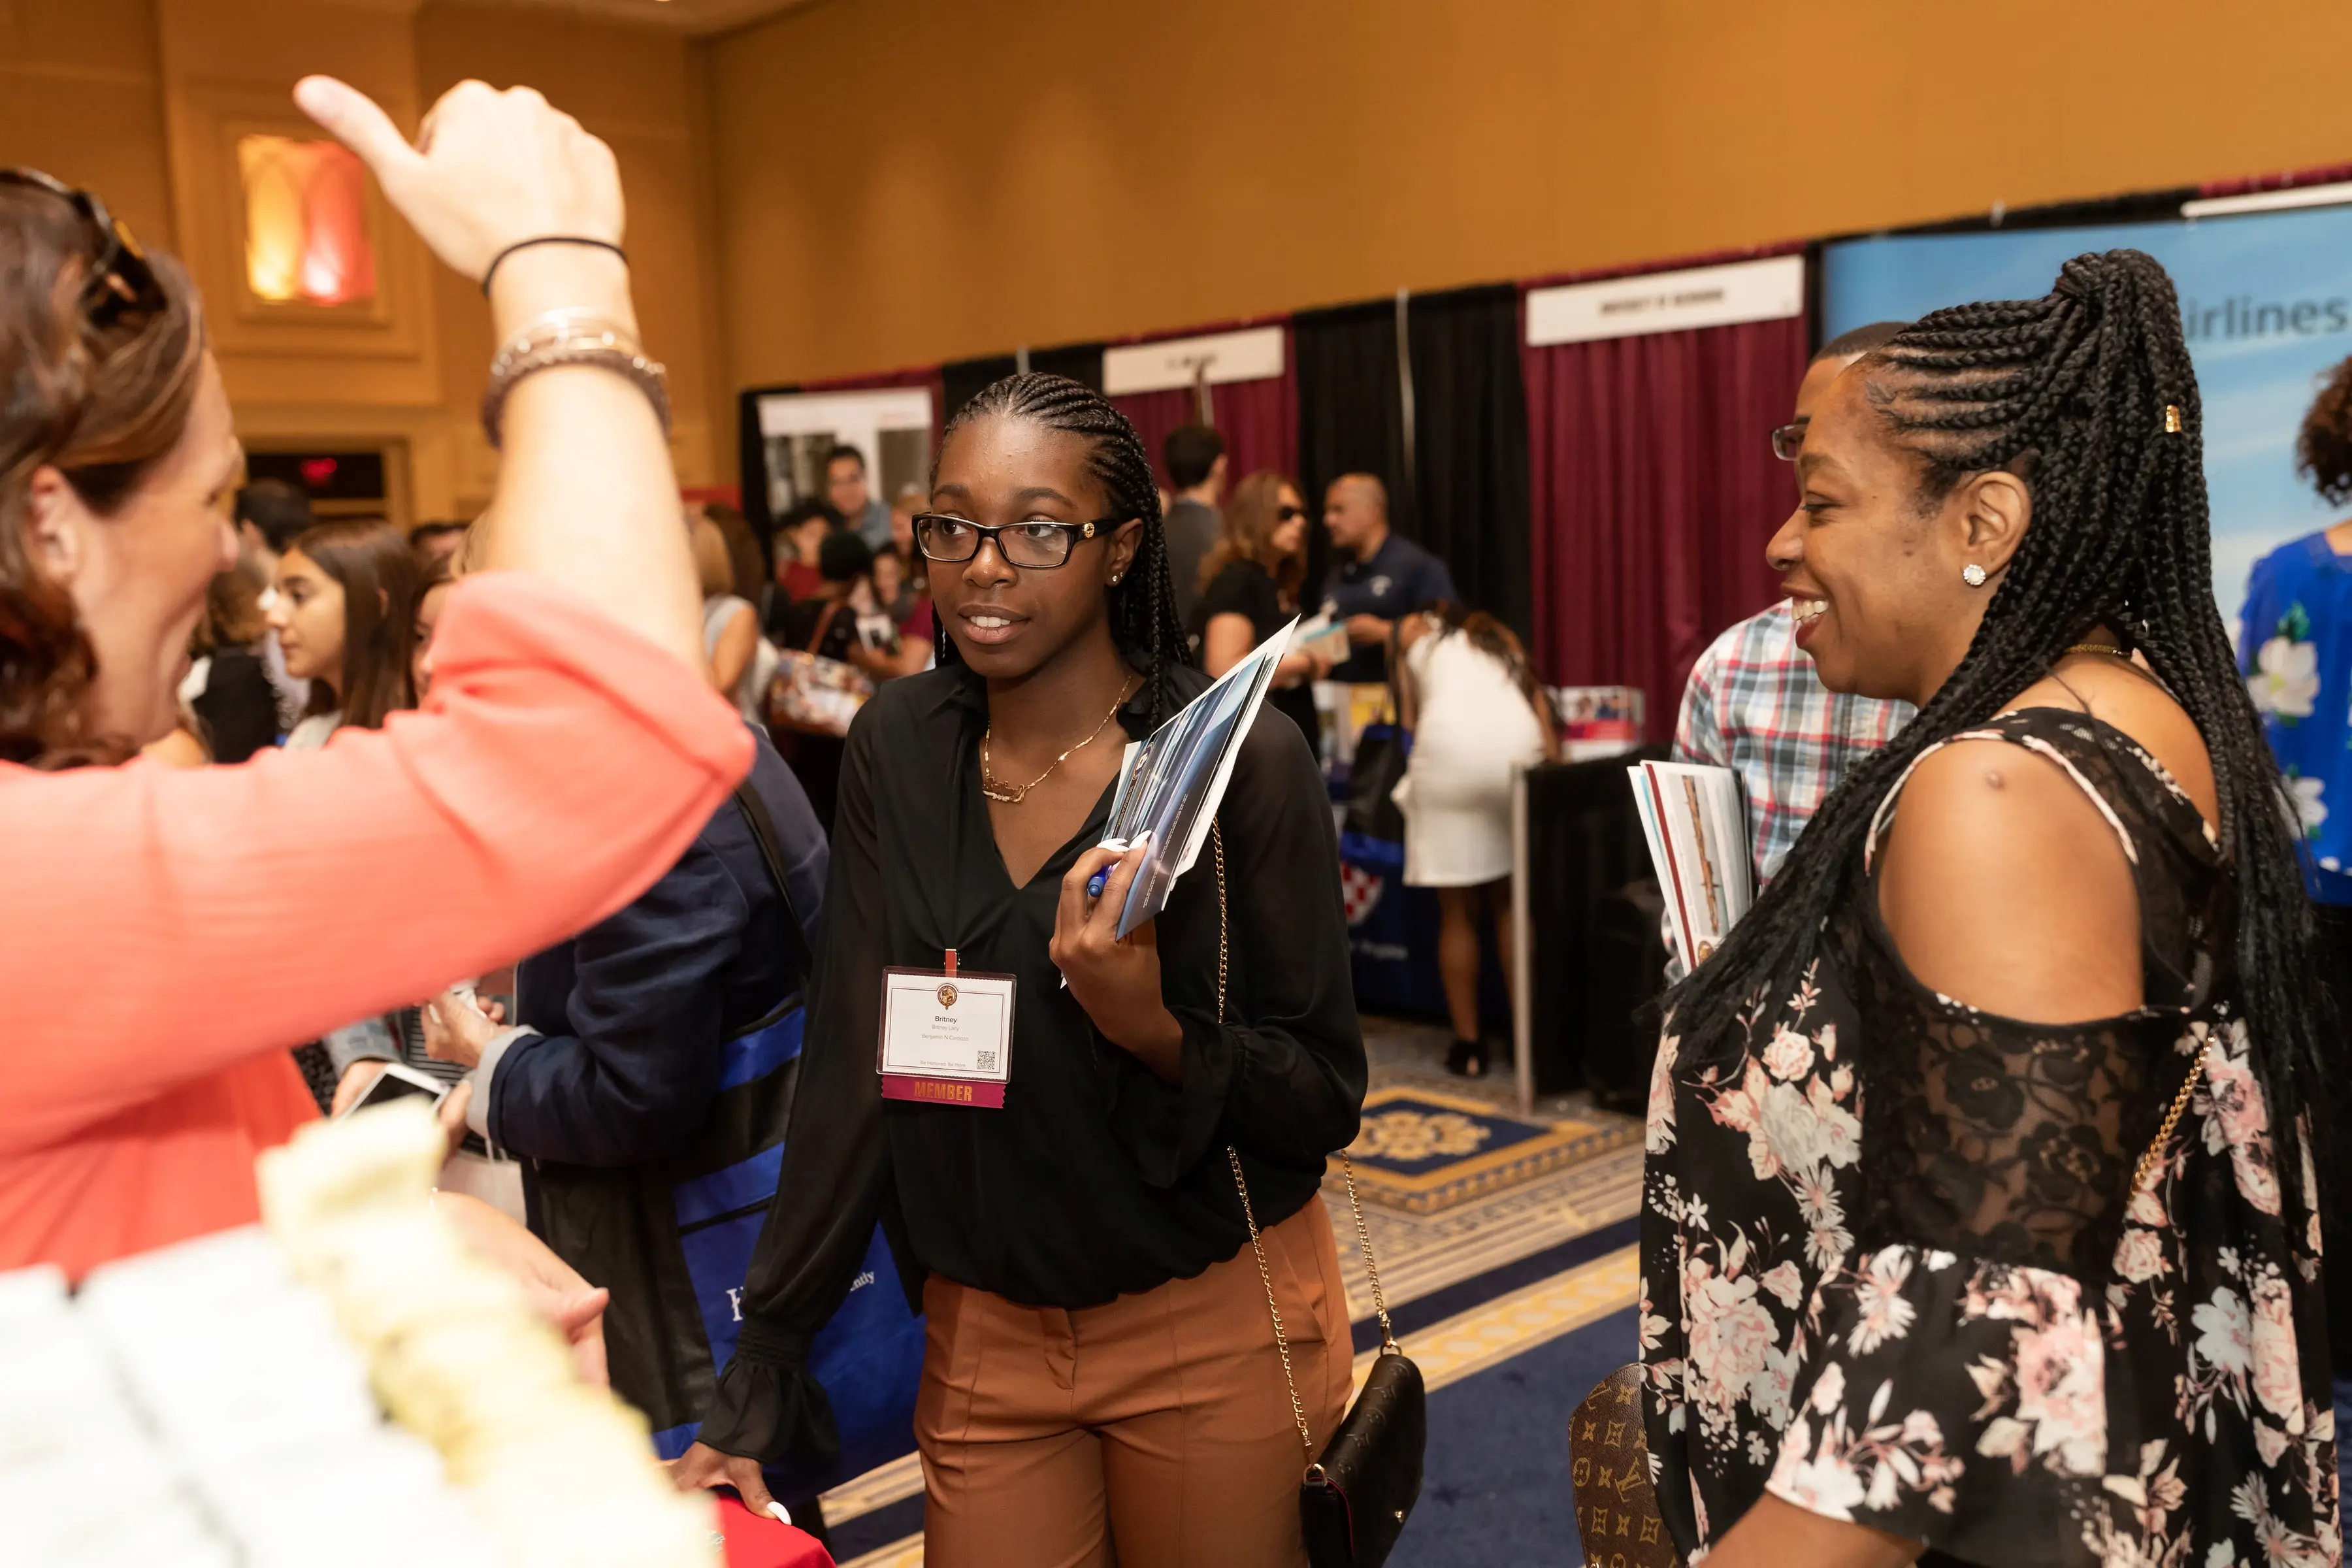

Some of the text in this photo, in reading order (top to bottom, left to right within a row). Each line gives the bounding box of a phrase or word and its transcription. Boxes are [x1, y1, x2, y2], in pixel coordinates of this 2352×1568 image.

[2187, 295, 2348, 338] irlines
[935, 1015, 957, 1024] Britney
[915, 1081, 973, 1101] MEMBER
